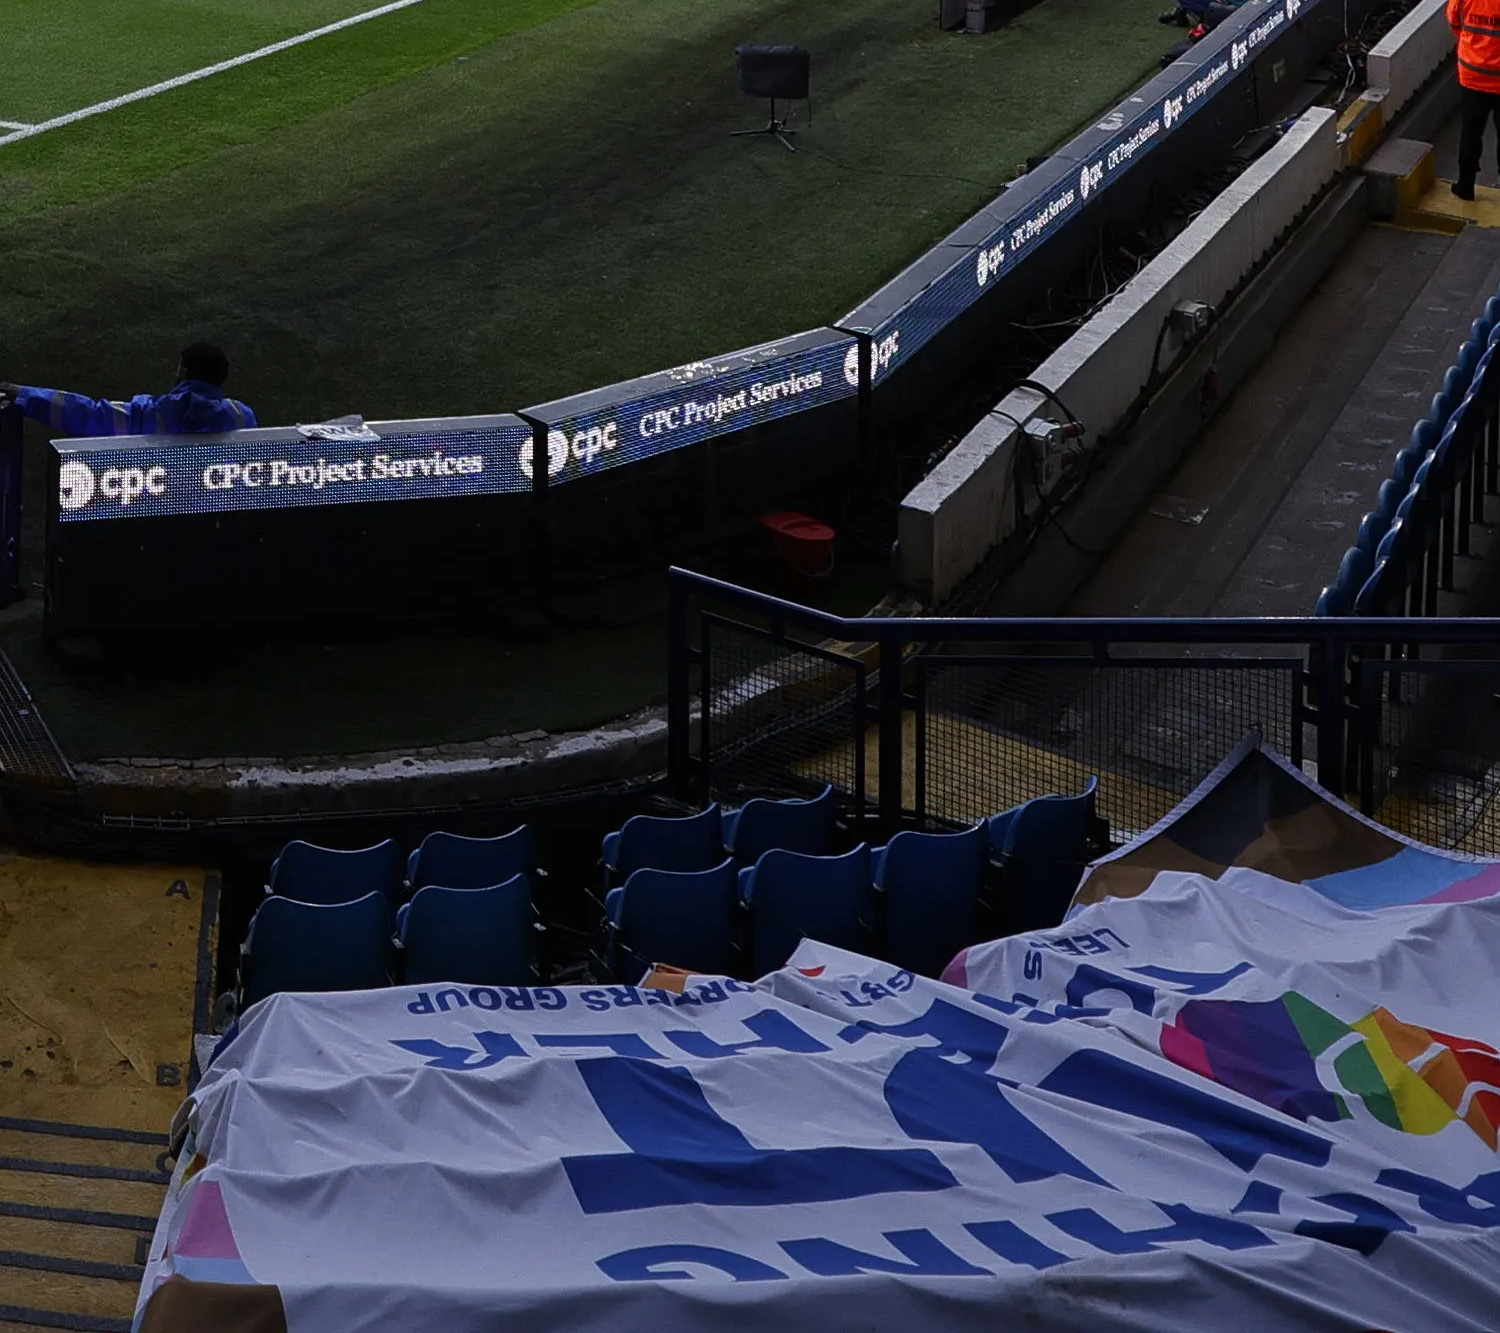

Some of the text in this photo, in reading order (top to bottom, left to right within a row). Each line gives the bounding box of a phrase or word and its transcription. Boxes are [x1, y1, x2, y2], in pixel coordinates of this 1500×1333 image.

[988, 190, 1074, 274] cpc CPC Project Services
[573, 369, 823, 464] cpc CPC Project Services
[103, 450, 484, 504] cpc CPC Project Services
[165, 878, 191, 899] A
[407, 987, 569, 1015] GROUP
[156, 1063, 181, 1087] B
